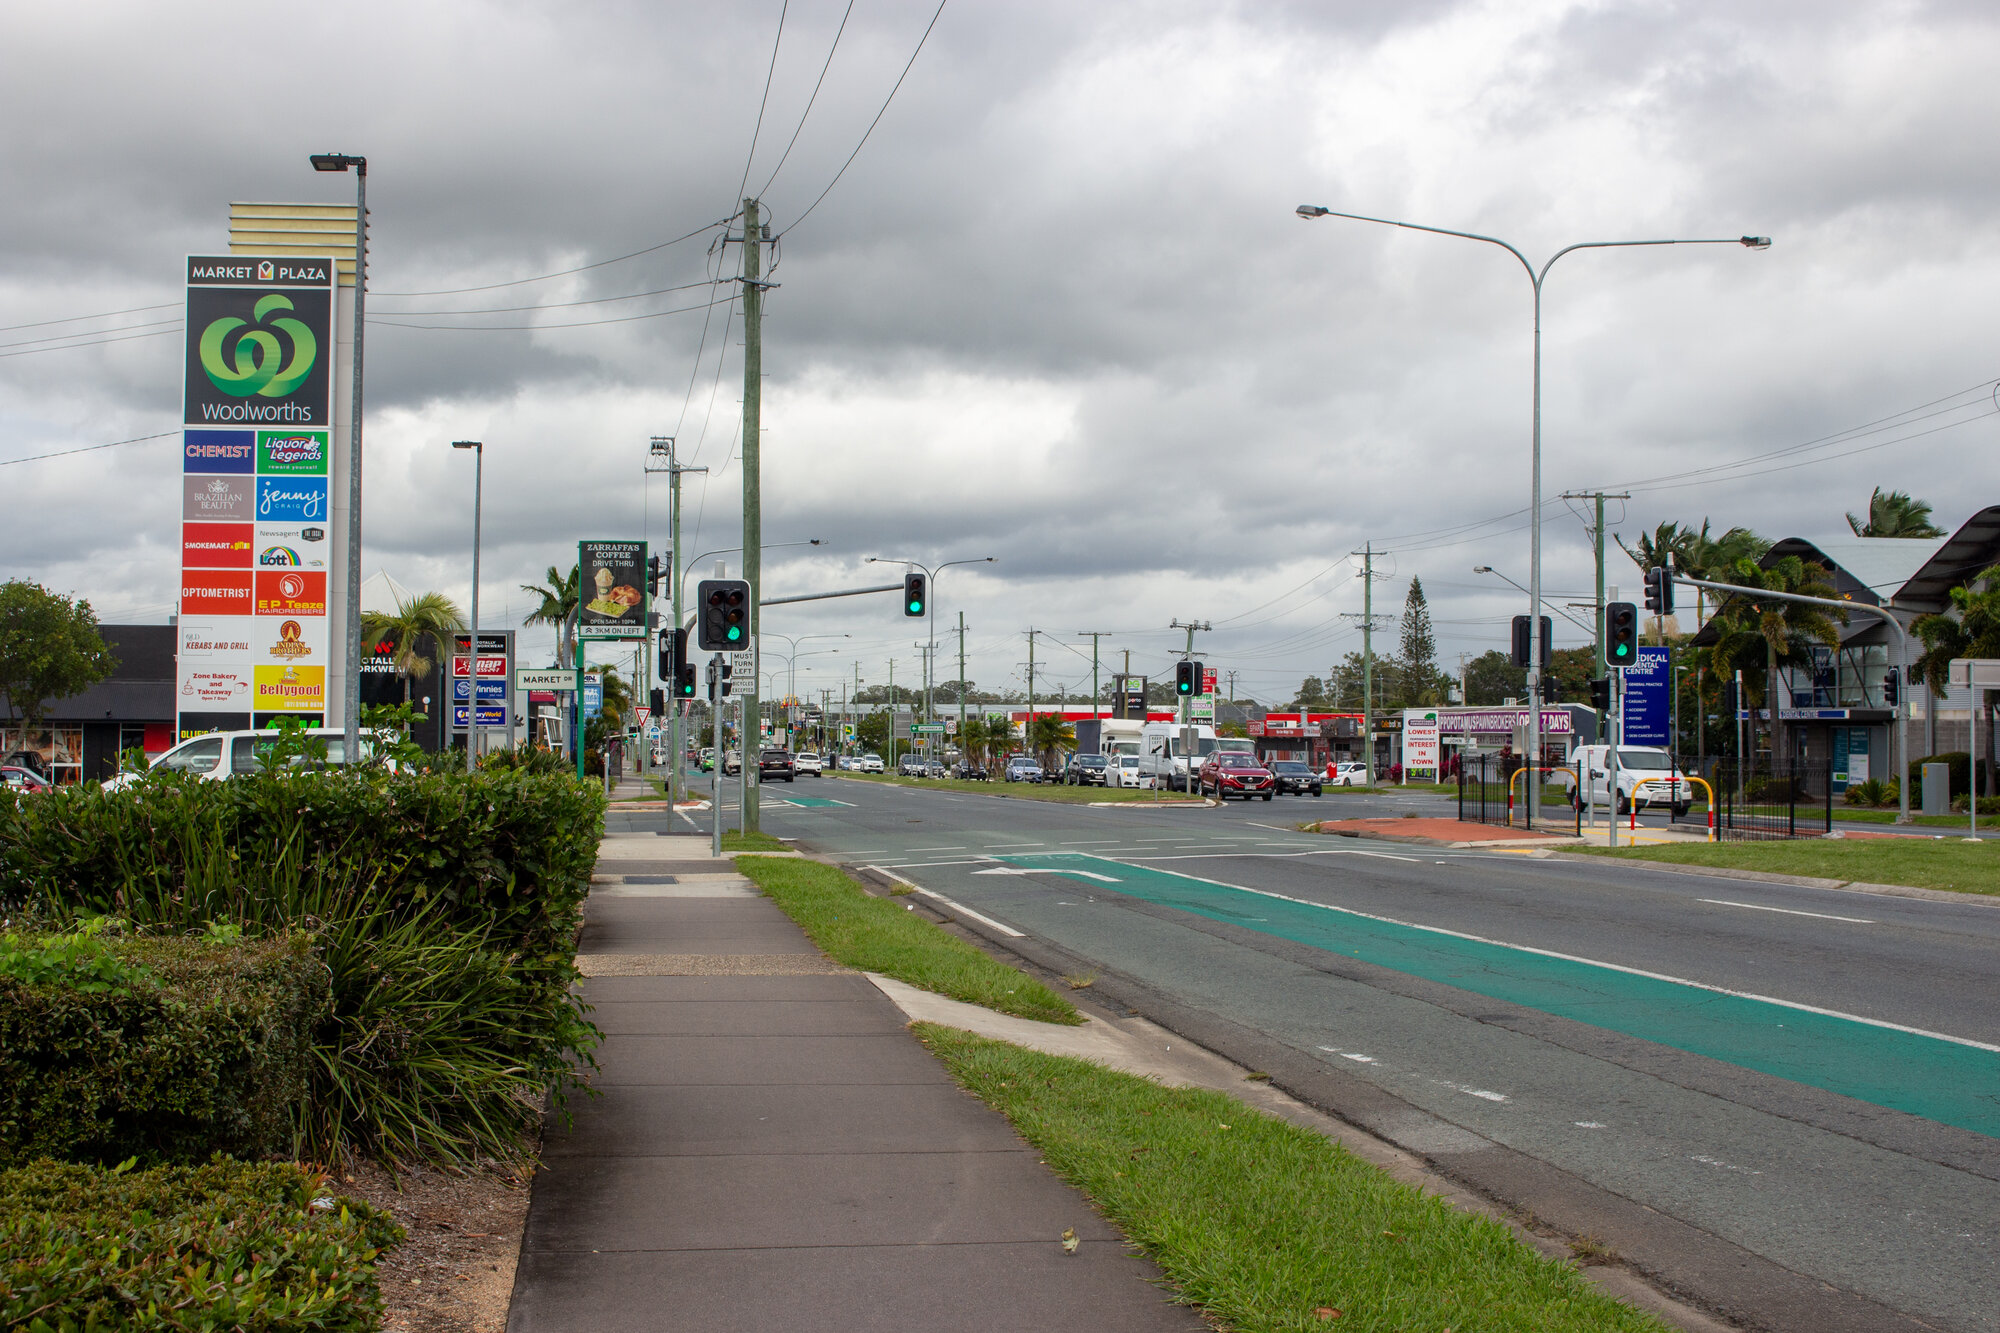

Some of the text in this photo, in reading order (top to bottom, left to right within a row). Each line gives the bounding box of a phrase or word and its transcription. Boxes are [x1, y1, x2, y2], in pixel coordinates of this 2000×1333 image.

[192, 266, 326, 280] MARKET PLAZA
[202, 400, 312, 421] Woolworths
[265, 437, 306, 451] Liquor
[186, 445, 252, 458] CHEMIST
[270, 449, 323, 463] Legends
[194, 493, 243, 502] BRAZILIAN
[260, 481, 325, 518] jenny
[201, 501, 235, 510] BEAUTY
[259, 530, 299, 538] Newsagent
[184, 542, 230, 550] SMOKEMART
[587, 544, 639, 552] ZARRAFFA'S
[260, 555, 288, 566] Lott
[182, 588, 251, 598] OPTOMETRIST
[258, 600, 324, 609] E P Teaze
[185, 641, 249, 650] KEBABS AND GRILL
[270, 647, 311, 655] BROTHERS
[1637, 654, 1667, 662] EDICAL
[212, 673, 237, 681] Bakery
[197, 689, 232, 697] Takeaway
[260, 683, 321, 696] Bellygood
[1549, 715, 1569, 730] DAYS
